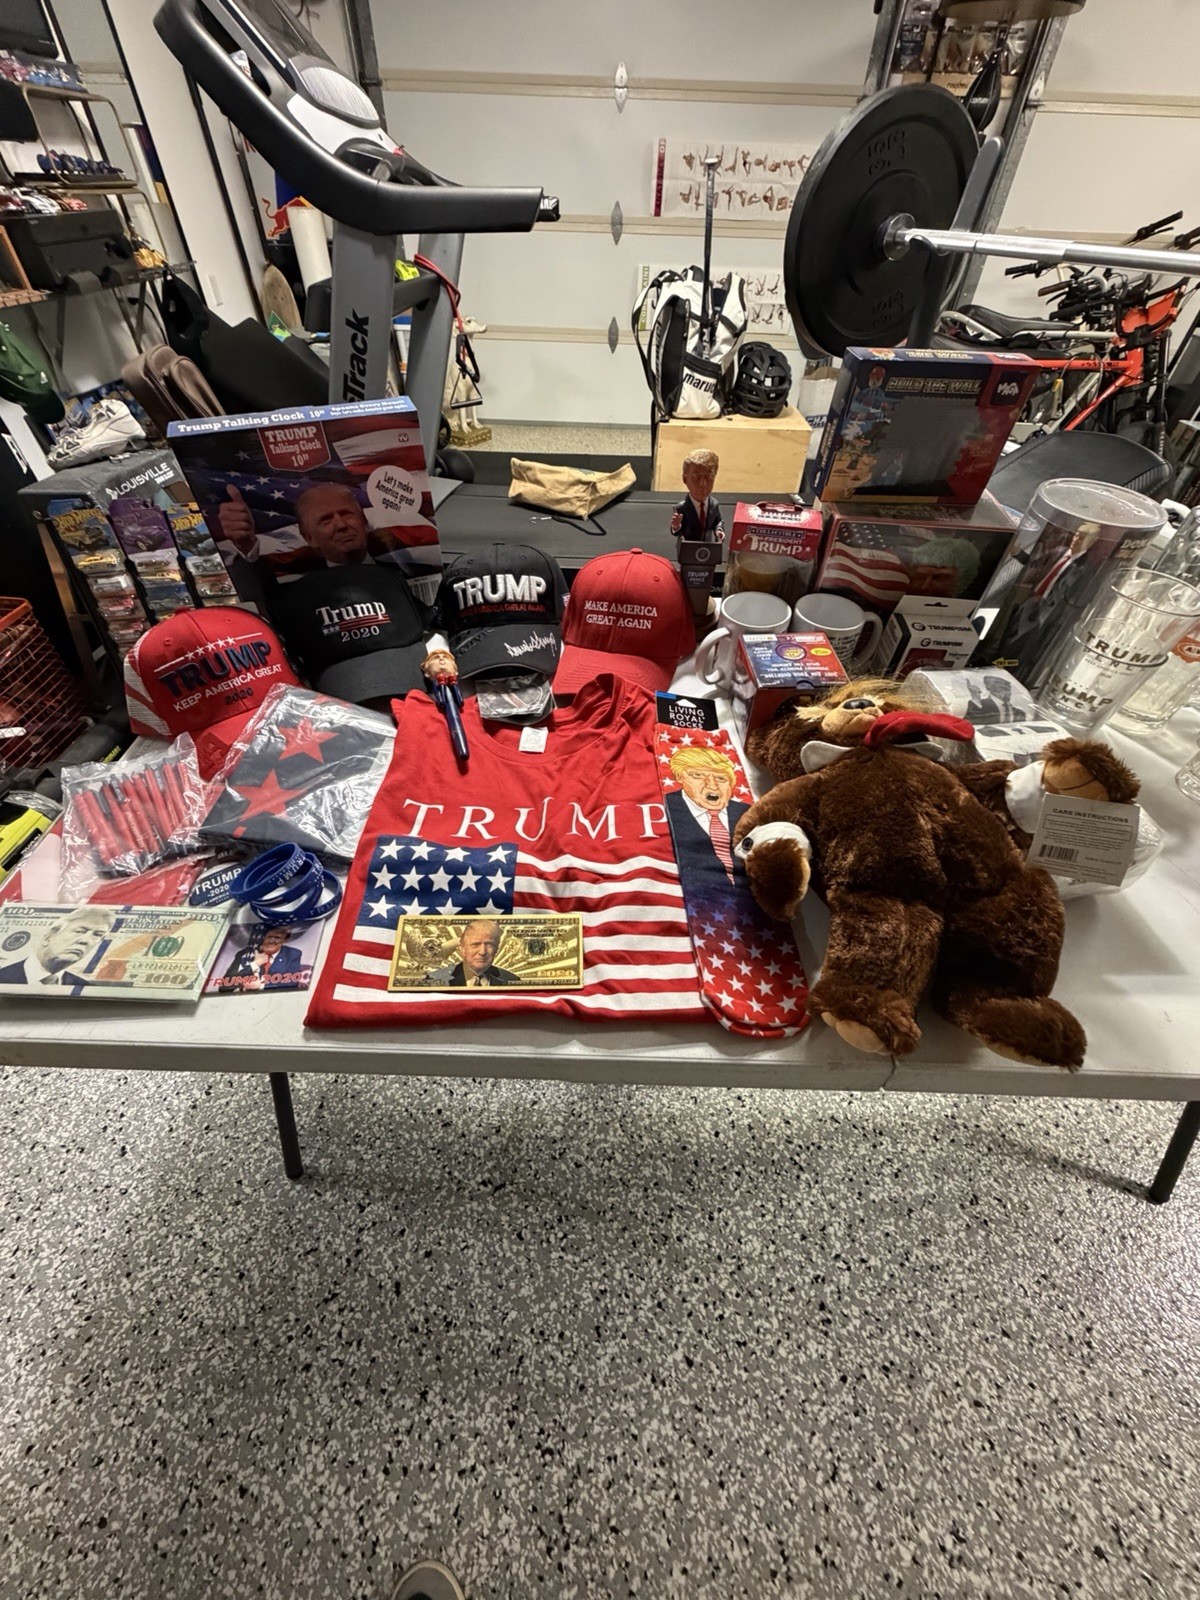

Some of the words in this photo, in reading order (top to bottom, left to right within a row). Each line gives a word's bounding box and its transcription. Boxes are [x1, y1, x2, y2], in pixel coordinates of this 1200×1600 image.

[178, 422, 221, 433] Trump
[222, 415, 269, 428] Talking
[271, 411, 305, 422] Clock
[264, 426, 317, 442] TRUMP
[268, 442, 300, 454] Talking
[299, 439, 323, 451] Clock
[114, 462, 171, 496] LOUISVILLE
[396, 480, 414, 495] make
[375, 480, 400, 500] America
[399, 495, 416, 507] great
[743, 534, 802, 555] TRUMP
[763, 536, 803, 545] PRESIDENT
[453, 574, 547, 610] TRUMP
[315, 601, 387, 626] Trump
[583, 600, 609, 612] MAKE
[609, 603, 658, 622] AMERICA
[586, 613, 617, 626] GREAT
[616, 617, 652, 629] AGAIN
[340, 625, 380, 642] 2020
[1085, 631, 1163, 663] TRUMP
[158, 640, 271, 697] TRUMP
[173, 693, 203, 713] KEEP
[205, 675, 255, 698] AMERICA
[254, 663, 283, 678] GREAT
[225, 687, 254, 704] 2020
[668, 704, 704, 717] LIVING
[669, 712, 704, 724] ROYAL
[673, 719, 703, 729] SOCKS
[402, 796, 668, 842] TRUMP
[1052, 807, 1074, 817] CARE
[1074, 810, 1129, 823] INSTRUCTIONS
[277, 854, 306, 886] TRUMP
[194, 867, 242, 895] TRUMP
[142, 973, 189, 985] 100
[208, 975, 259, 987] TRUMP
[260, 972, 302, 985] 2020
[536, 969, 576, 977] 2020
